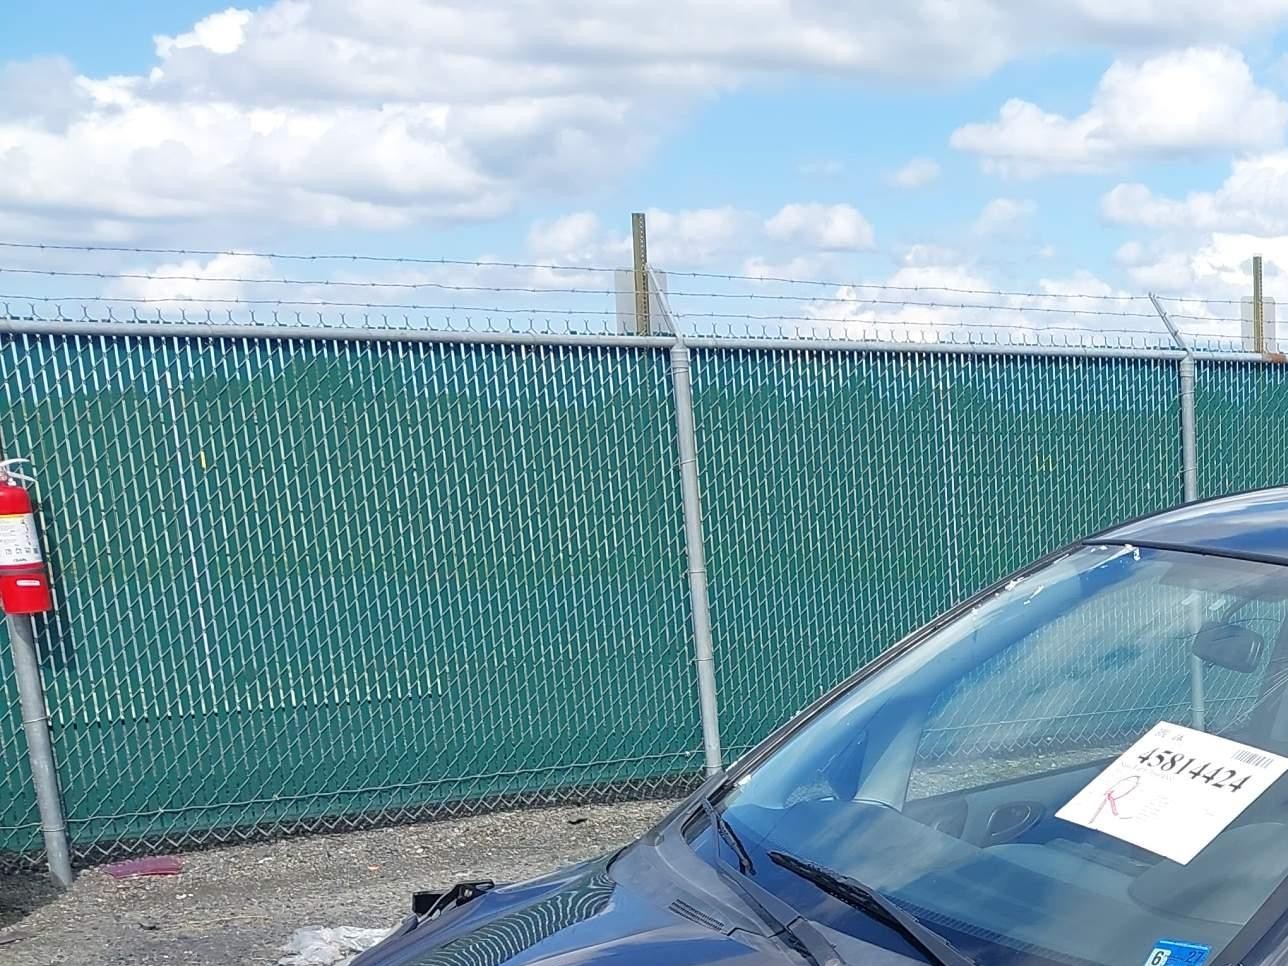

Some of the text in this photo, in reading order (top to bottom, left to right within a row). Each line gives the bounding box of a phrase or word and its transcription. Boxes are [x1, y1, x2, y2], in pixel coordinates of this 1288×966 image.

[1137, 747, 1251, 793] 45814424
[1088, 775, 1142, 825] R
[1151, 950, 1207, 966] 6 27
